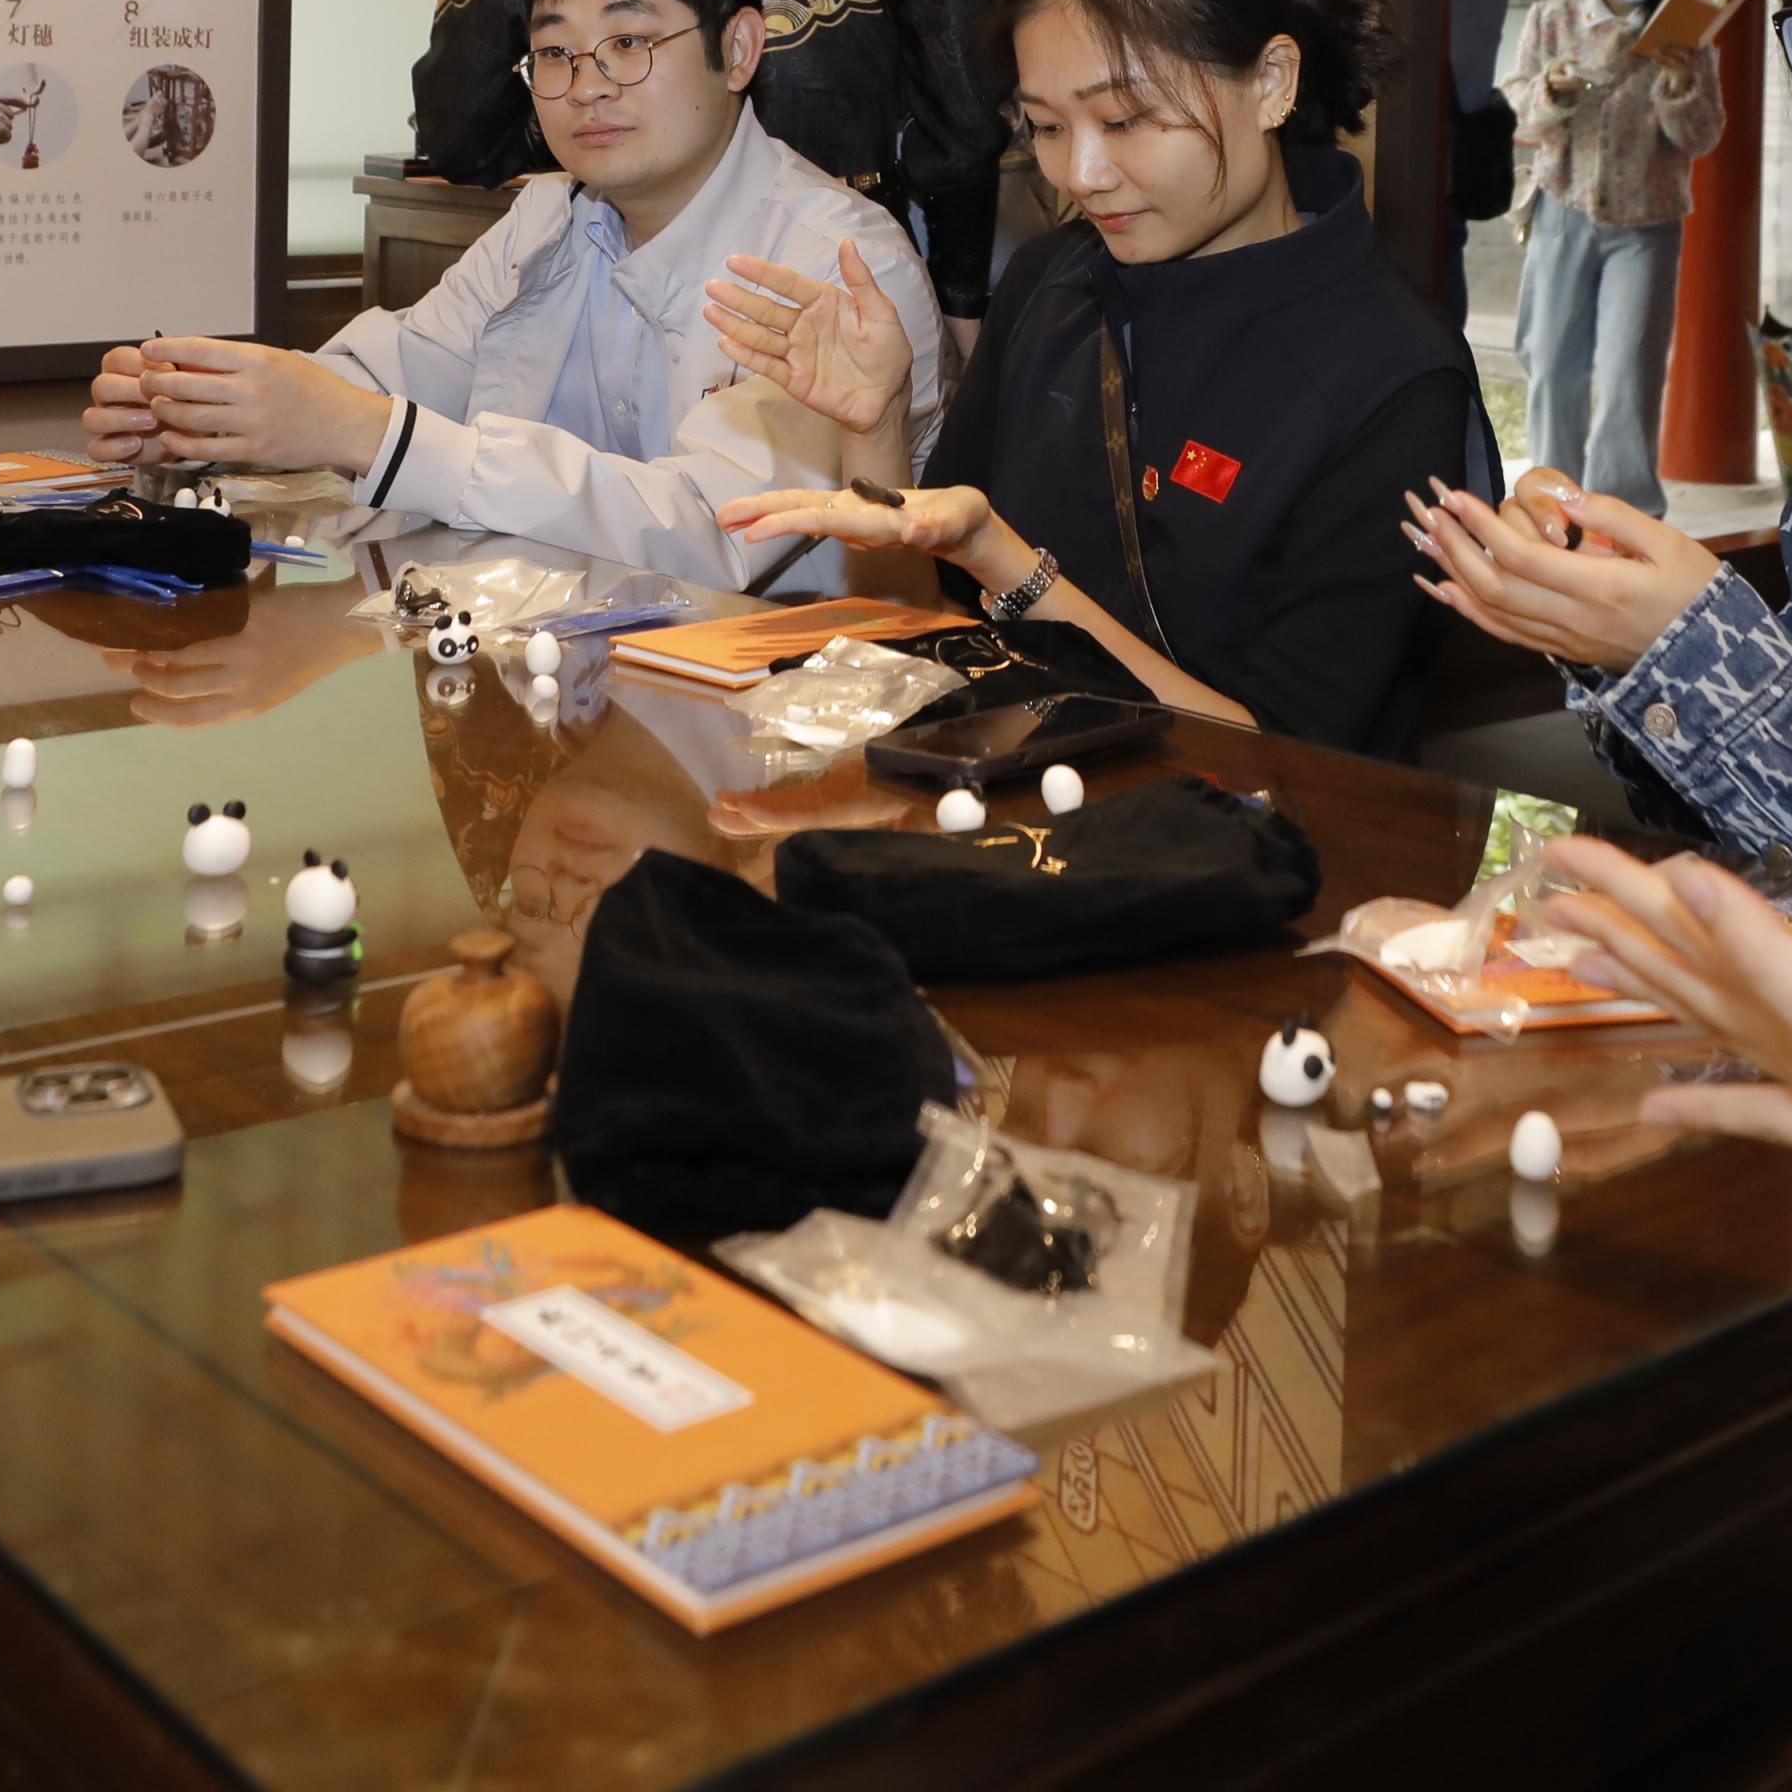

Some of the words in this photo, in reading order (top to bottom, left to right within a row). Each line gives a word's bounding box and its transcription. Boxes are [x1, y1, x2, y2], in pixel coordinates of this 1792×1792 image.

[124, 0, 140, 24] 8
[9, 23, 54, 49] 灯穗
[129, 23, 215, 50] 组装成灯
[1702, 609, 1744, 657] Y
[1653, 667, 1693, 707] Y
[1695, 662, 1752, 715] N
